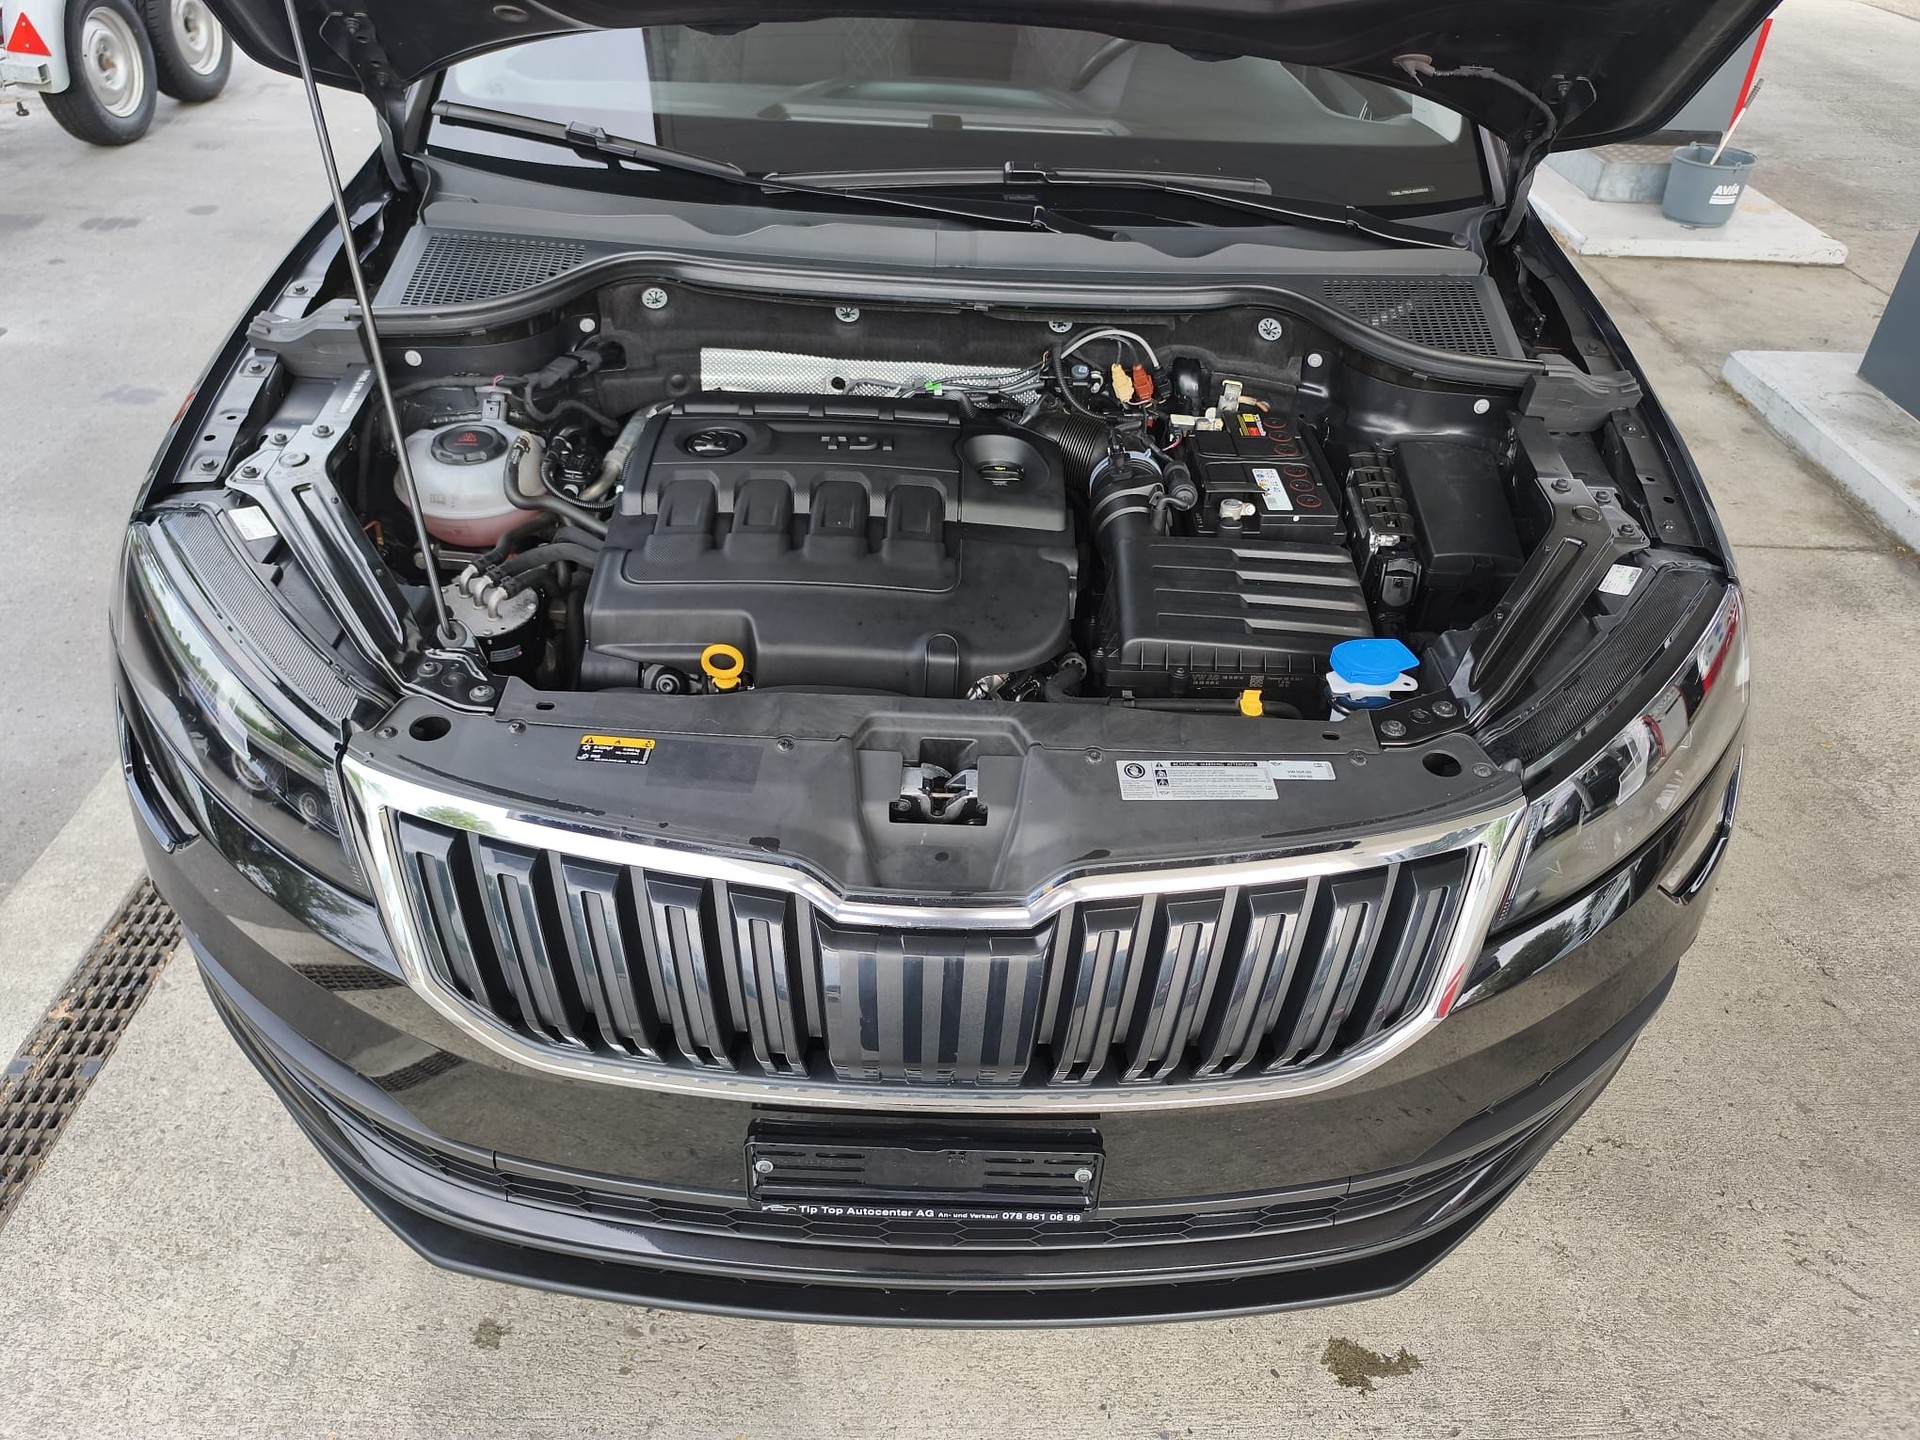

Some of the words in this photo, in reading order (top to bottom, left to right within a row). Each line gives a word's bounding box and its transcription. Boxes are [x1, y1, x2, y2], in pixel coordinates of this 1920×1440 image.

[1713, 183, 1740, 195] AVIA
[820, 436, 893, 451] TDI
[799, 1205, 818, 1214] Tip
[821, 1206, 844, 1215] Top
[846, 1206, 914, 1217] Autocenter
[916, 1209, 935, 1218] AG
[1002, 1212, 1023, 1220] 078
[1049, 1213, 1064, 1221] 06
[1066, 1214, 1081, 1222] 99
